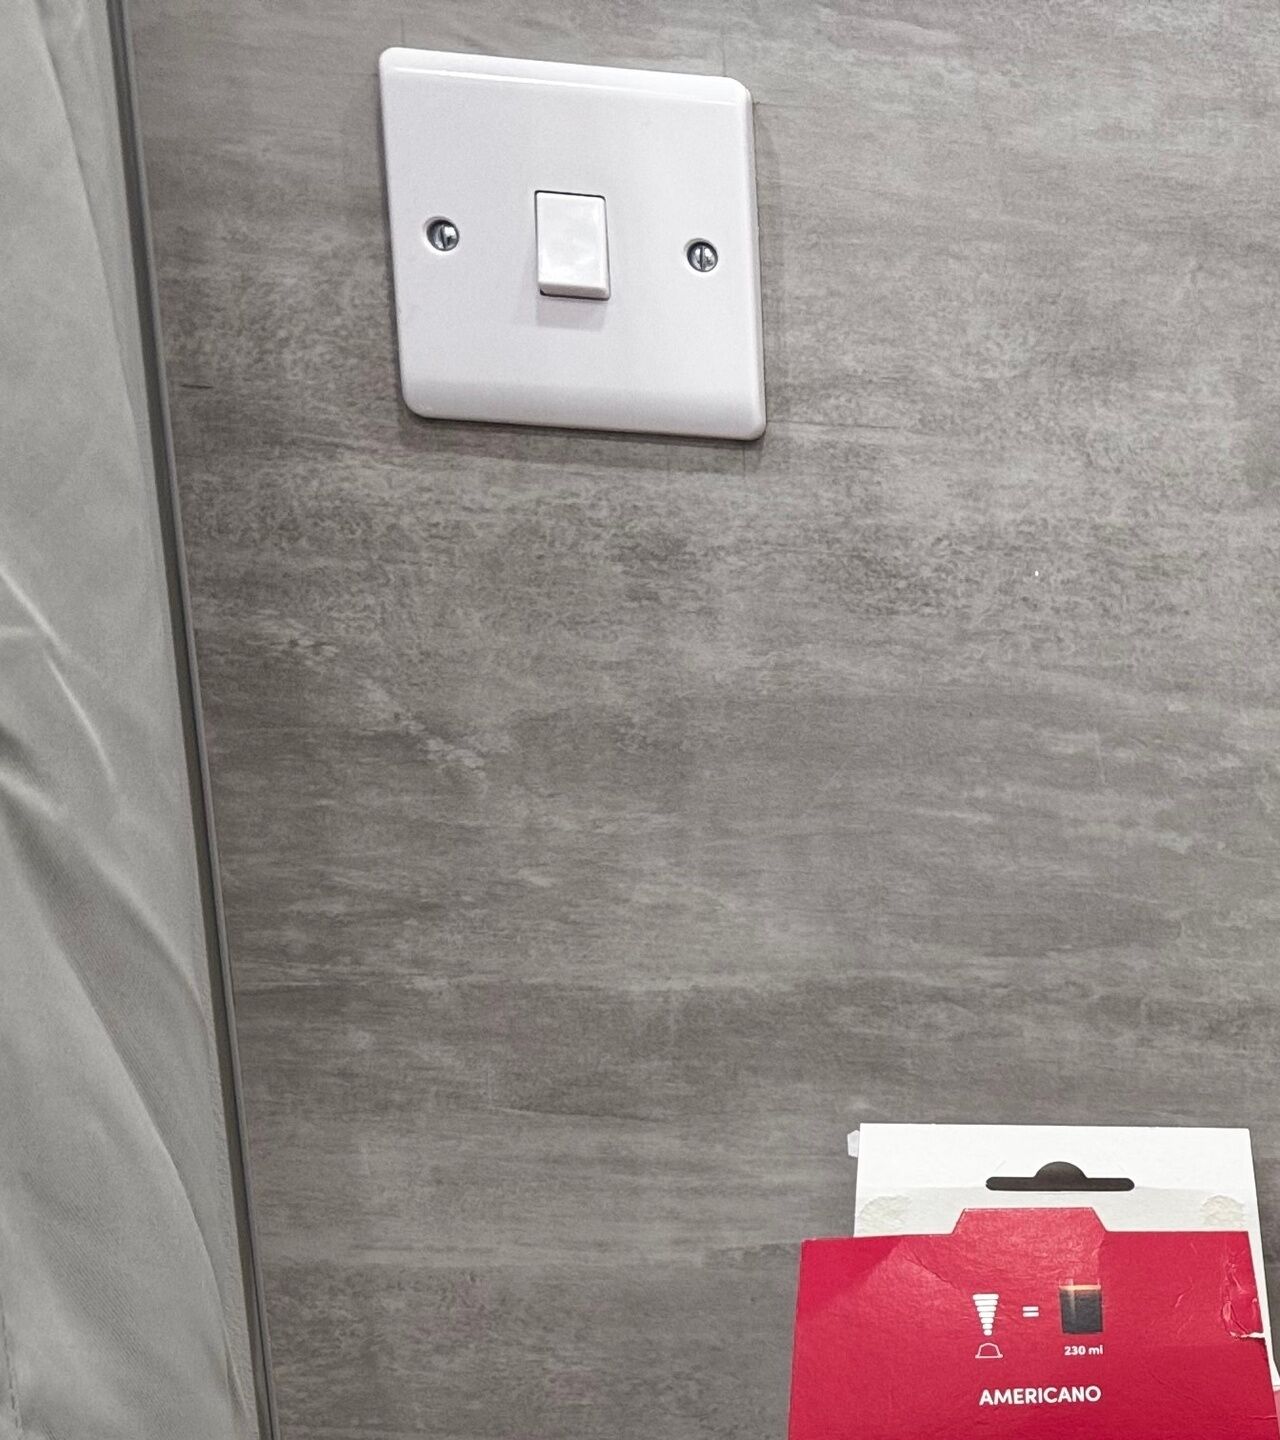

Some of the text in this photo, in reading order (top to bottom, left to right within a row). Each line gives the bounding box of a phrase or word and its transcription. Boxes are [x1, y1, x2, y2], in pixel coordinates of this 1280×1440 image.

[1064, 1344, 1104, 1356] 230 ml
[978, 1385, 1101, 1406] AMERICANO
